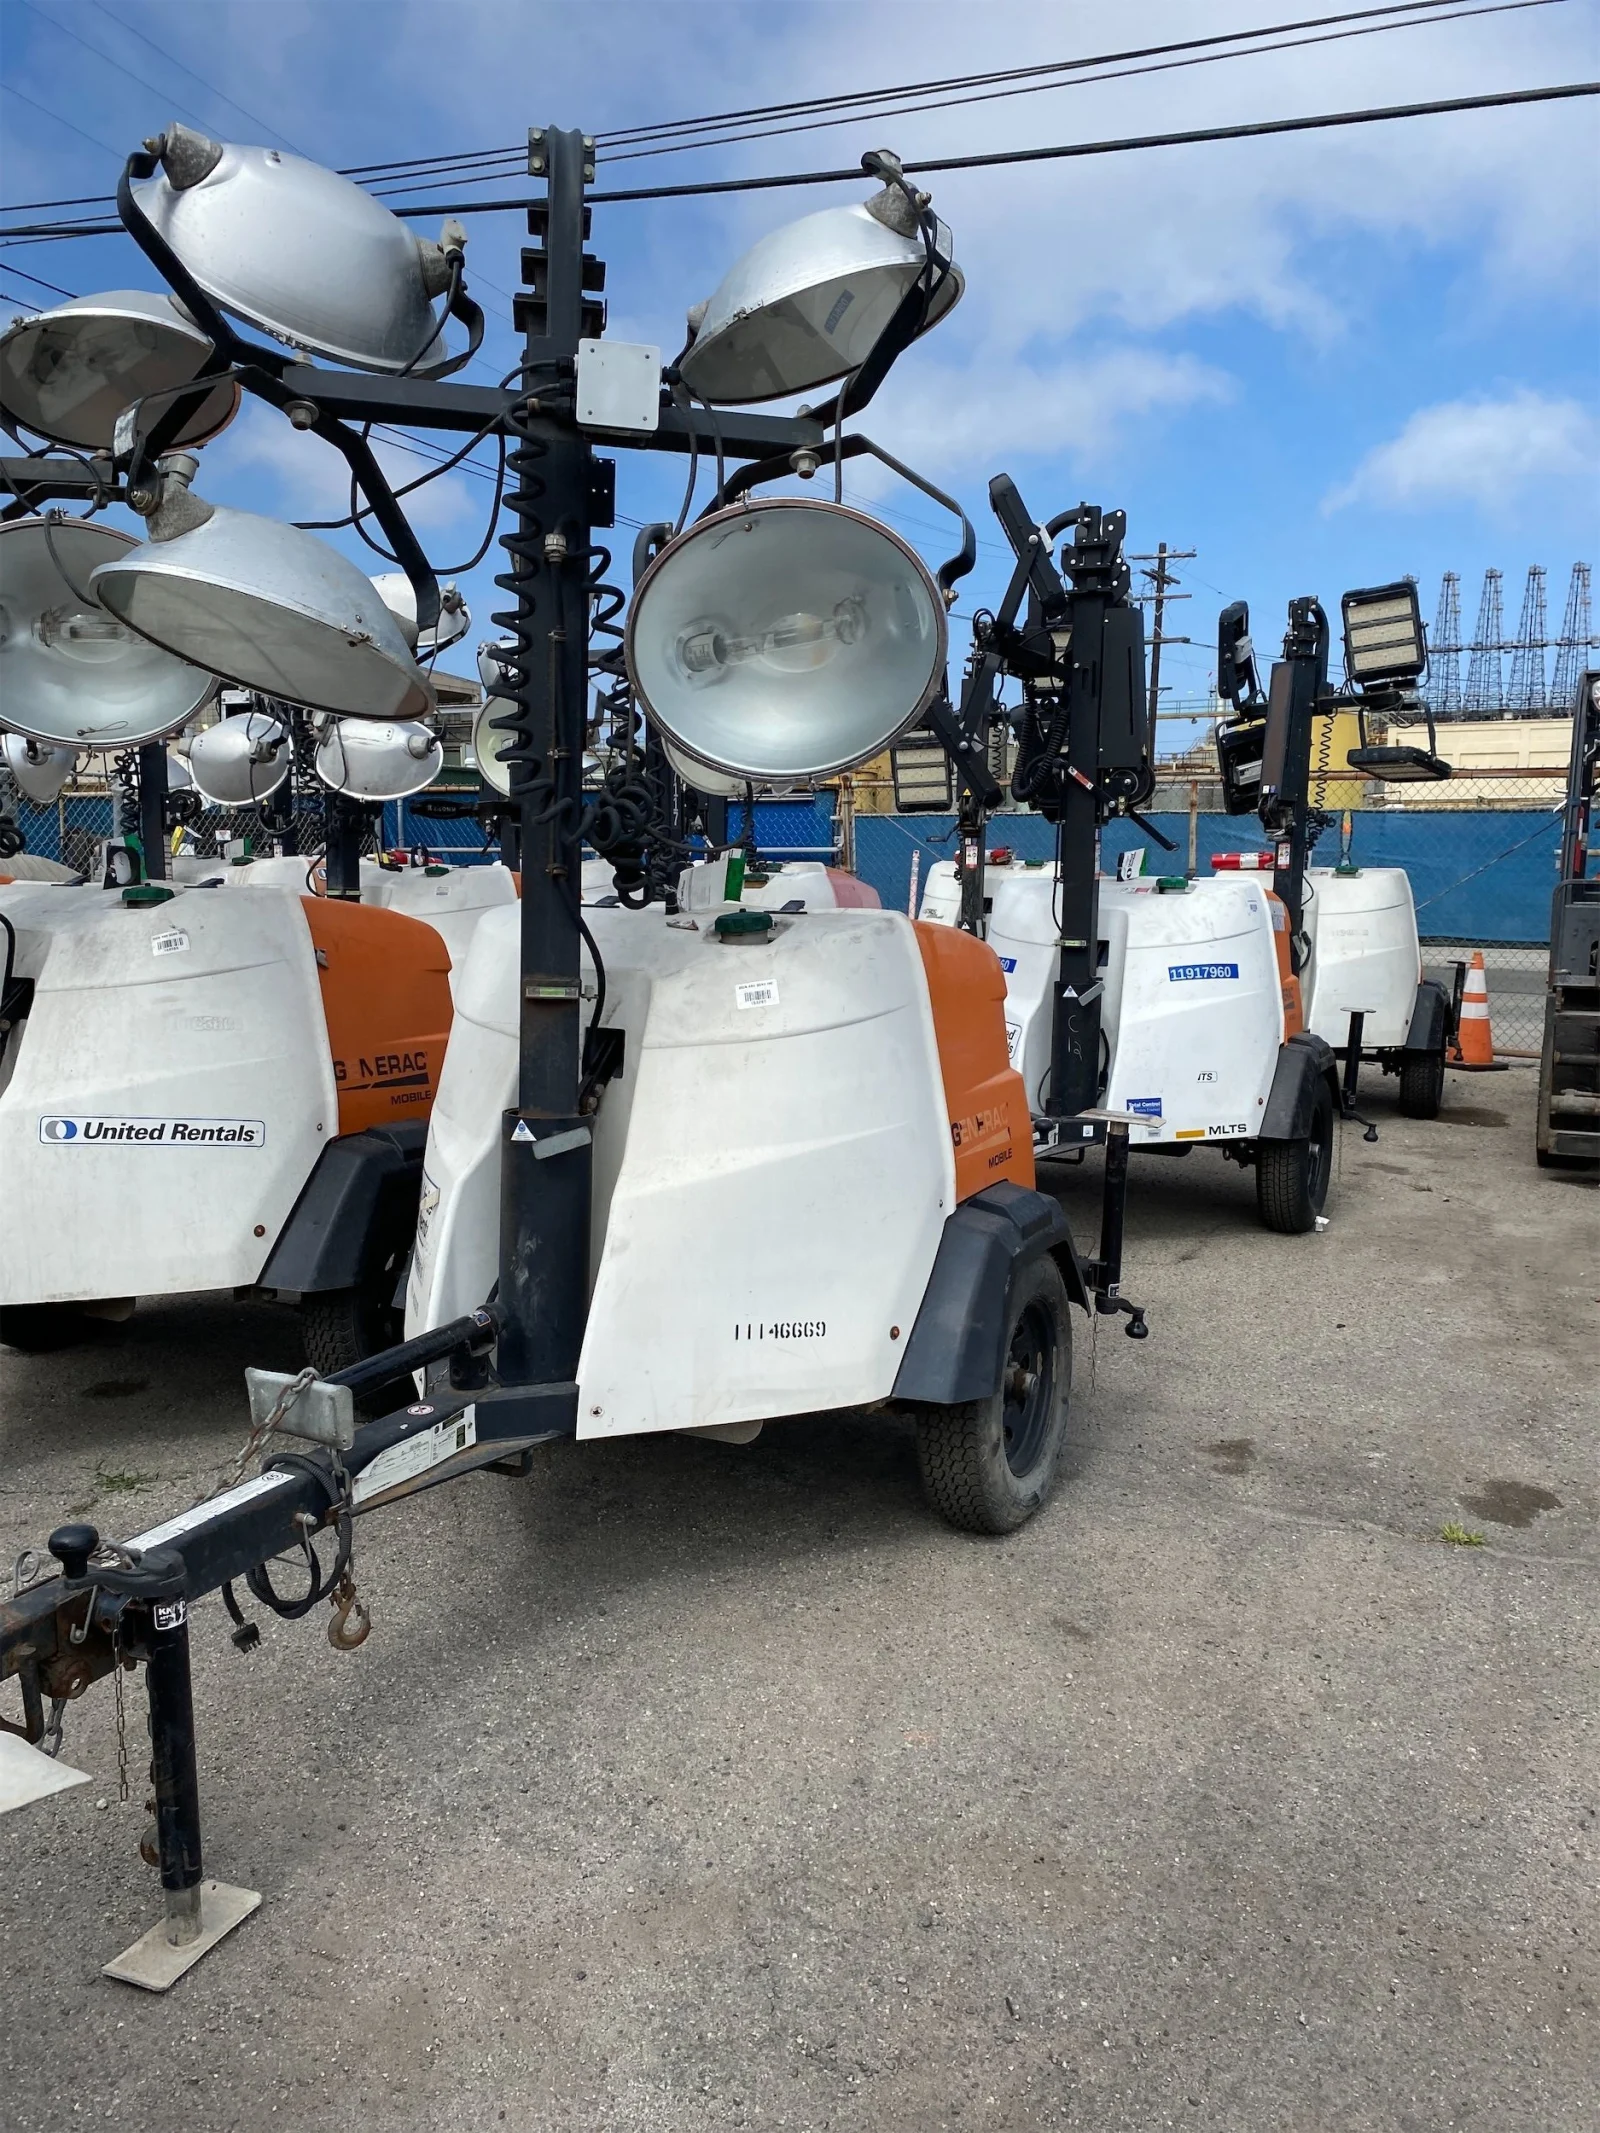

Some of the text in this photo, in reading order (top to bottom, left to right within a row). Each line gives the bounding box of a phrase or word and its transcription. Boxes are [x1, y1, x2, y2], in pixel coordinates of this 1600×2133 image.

[1170, 966, 1231, 981] 11917960
[333, 1051, 427, 1081] GNERAC
[390, 1090, 432, 1105] MOBILE
[83, 1121, 255, 1143] United Rentals
[1208, 1123, 1247, 1136] MLTS
[988, 1147, 1013, 1169] MOBILE
[735, 1321, 826, 1341] 11146669
